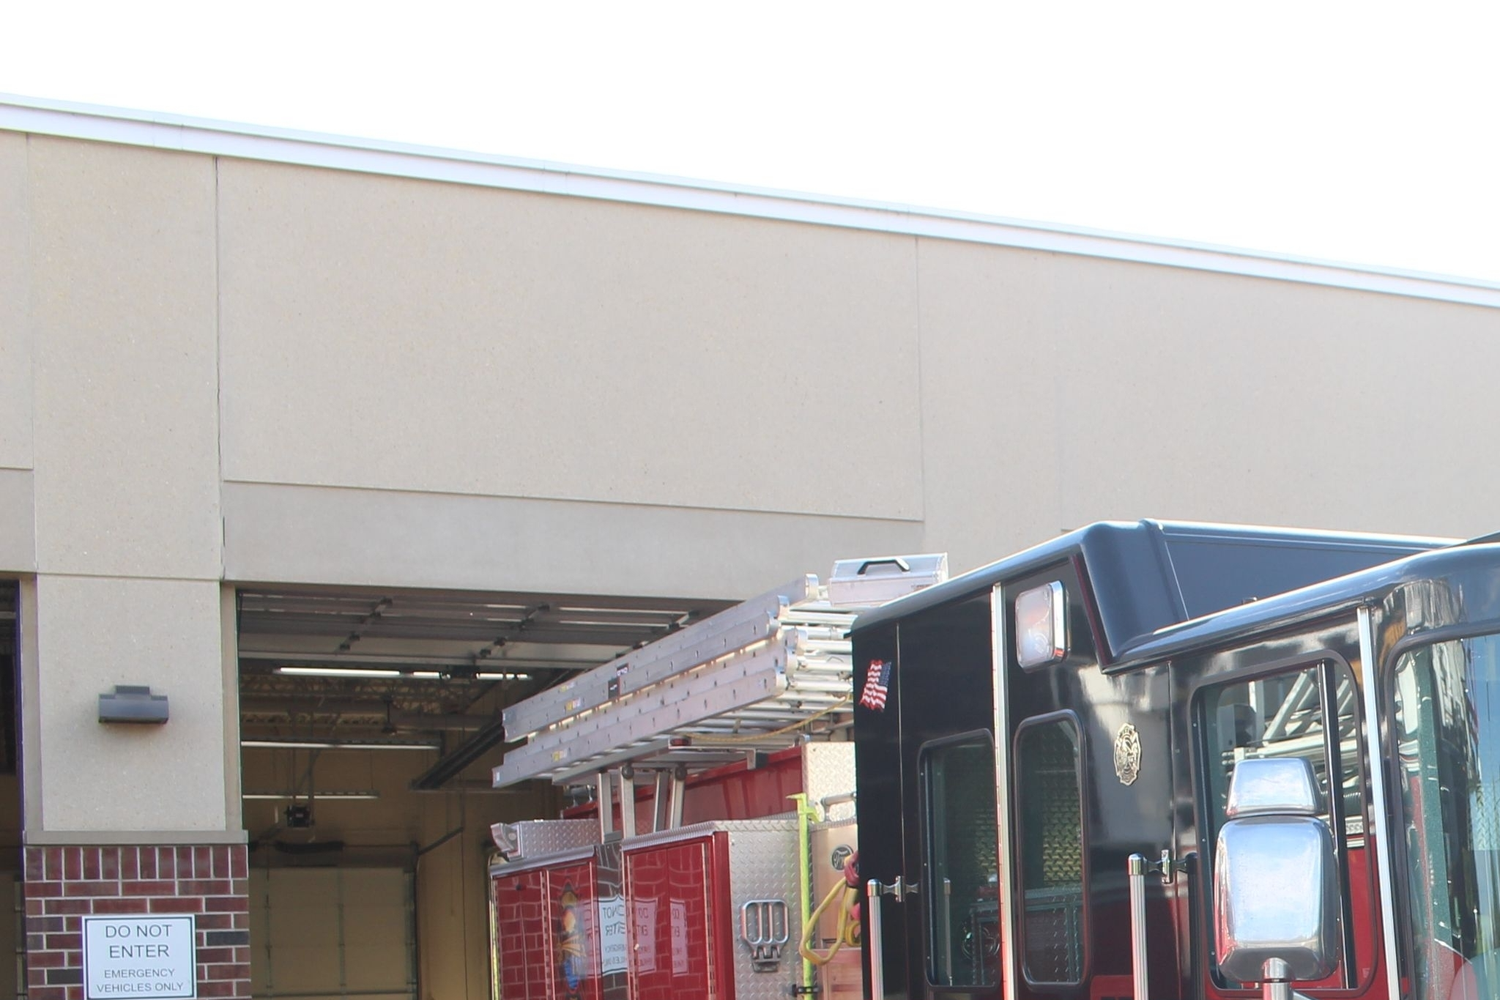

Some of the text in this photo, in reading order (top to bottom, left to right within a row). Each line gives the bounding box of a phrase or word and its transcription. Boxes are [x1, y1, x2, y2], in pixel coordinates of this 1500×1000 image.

[105, 924, 172, 938] DO NOT
[109, 944, 169, 958] ENTER
[104, 968, 175, 978] EMERGENCY
[96, 982, 184, 993] VEHICLES ONLY
